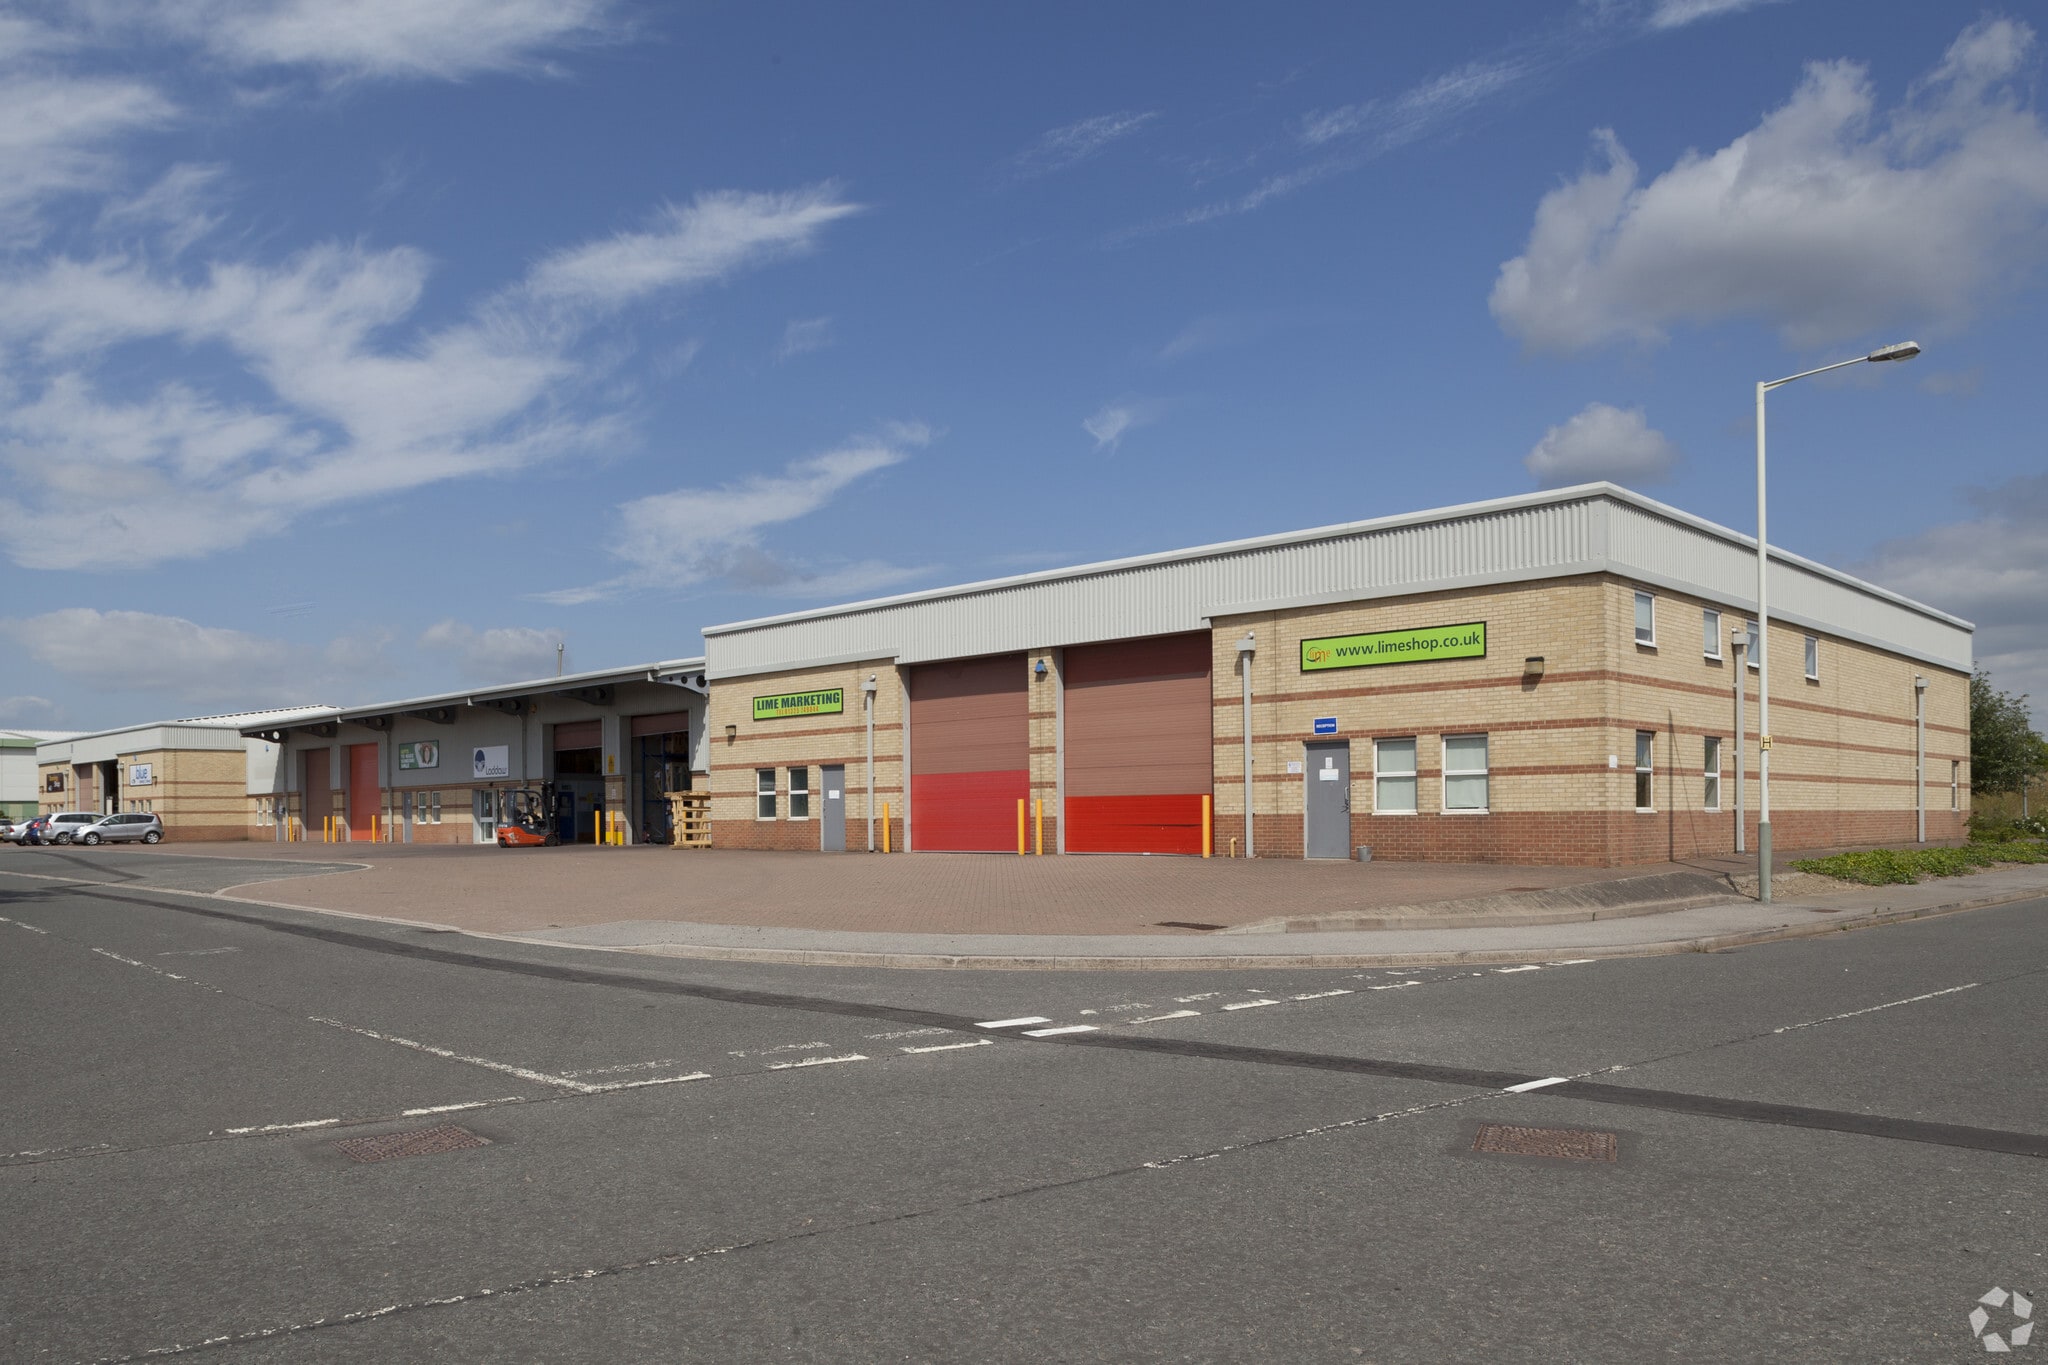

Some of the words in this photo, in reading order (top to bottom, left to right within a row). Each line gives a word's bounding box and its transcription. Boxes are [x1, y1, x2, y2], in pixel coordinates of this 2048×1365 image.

[1336, 631, 1480, 657] www.limeshop.co.uk
[756, 699, 779, 711] LIME
[781, 692, 840, 709] MARKETING
[1762, 736, 1771, 748] H
